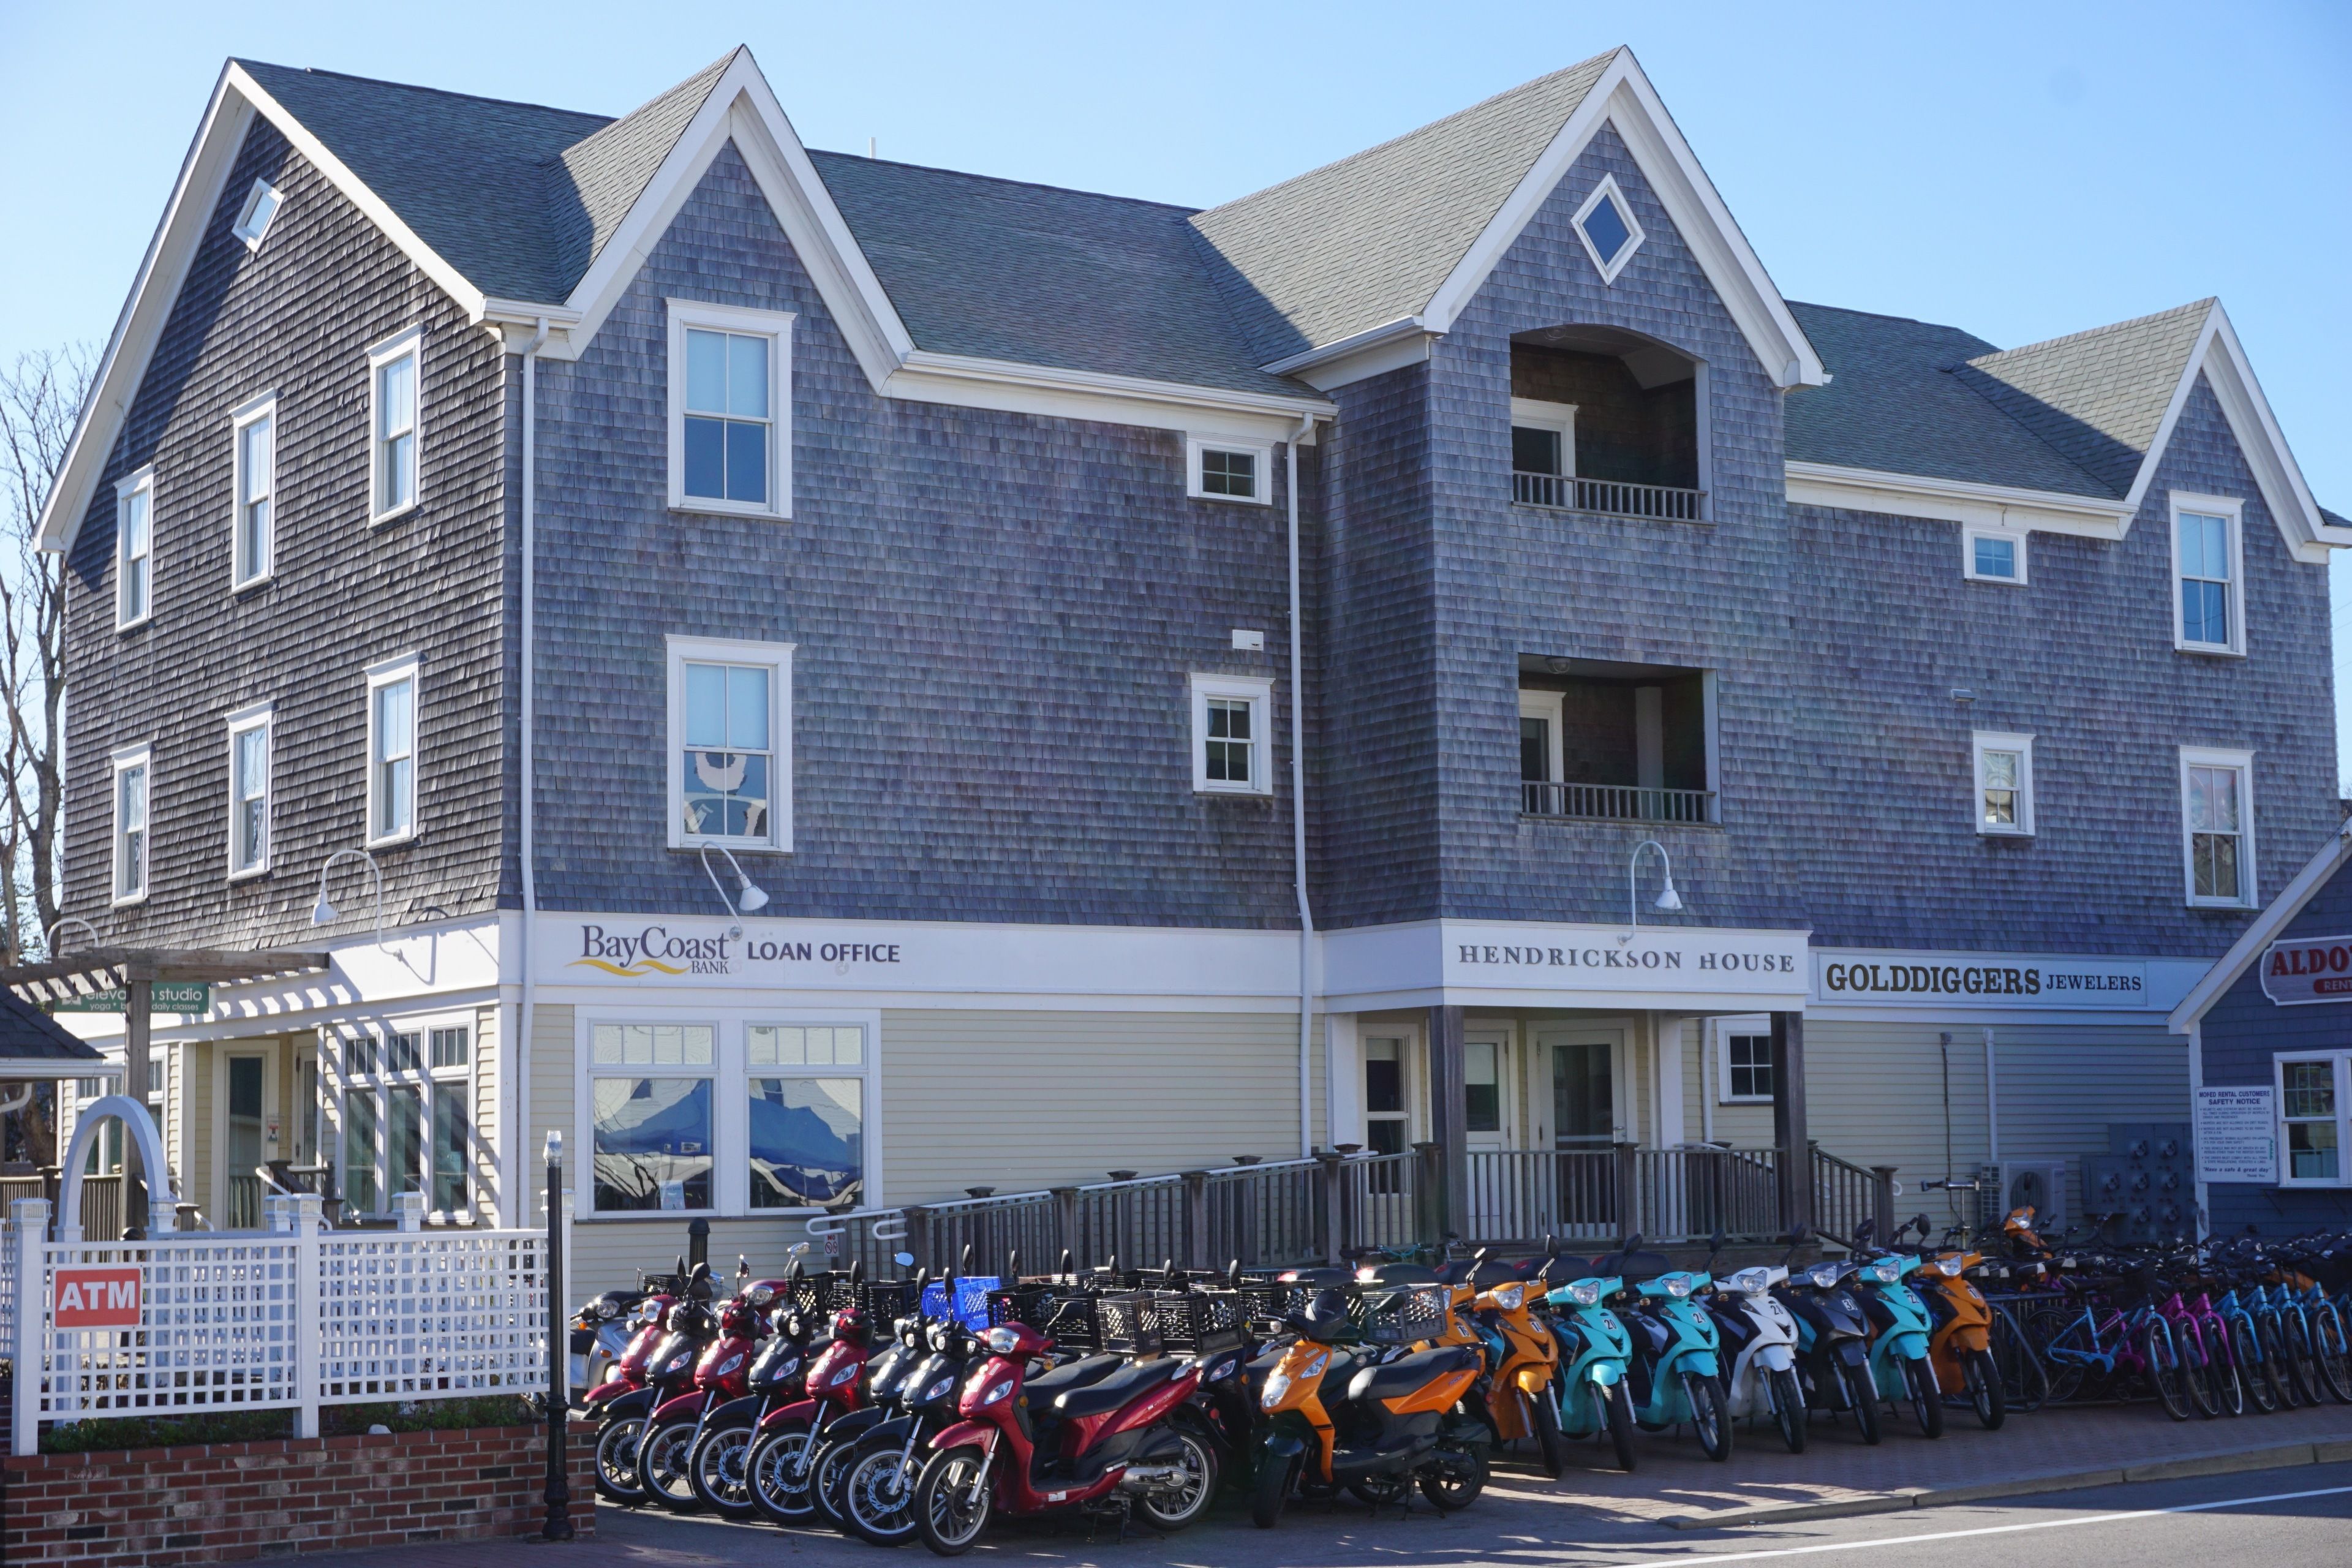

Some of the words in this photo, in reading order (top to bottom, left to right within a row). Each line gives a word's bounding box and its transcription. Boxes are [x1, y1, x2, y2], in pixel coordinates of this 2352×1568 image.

[581, 925, 729, 968] BayCoast
[748, 941, 812, 960] LOAN
[820, 943, 900, 963] OFFICE
[1458, 945, 1682, 969] HENDRICKSON
[1699, 952, 1795, 972] HOUSE
[691, 960, 730, 974] BANK
[1826, 963, 2041, 995] GOLDDIGGERS
[2046, 974, 2142, 992] JEWELERS
[159, 987, 202, 1001] studio
[152, 1001, 170, 1011] daily
[172, 1001, 198, 1010] classes
[58, 1281, 135, 1311] ATM
[1770, 1305, 1783, 1315] 28
[1604, 1319, 1617, 1330] 20
[1693, 1313, 1706, 1324] 24
